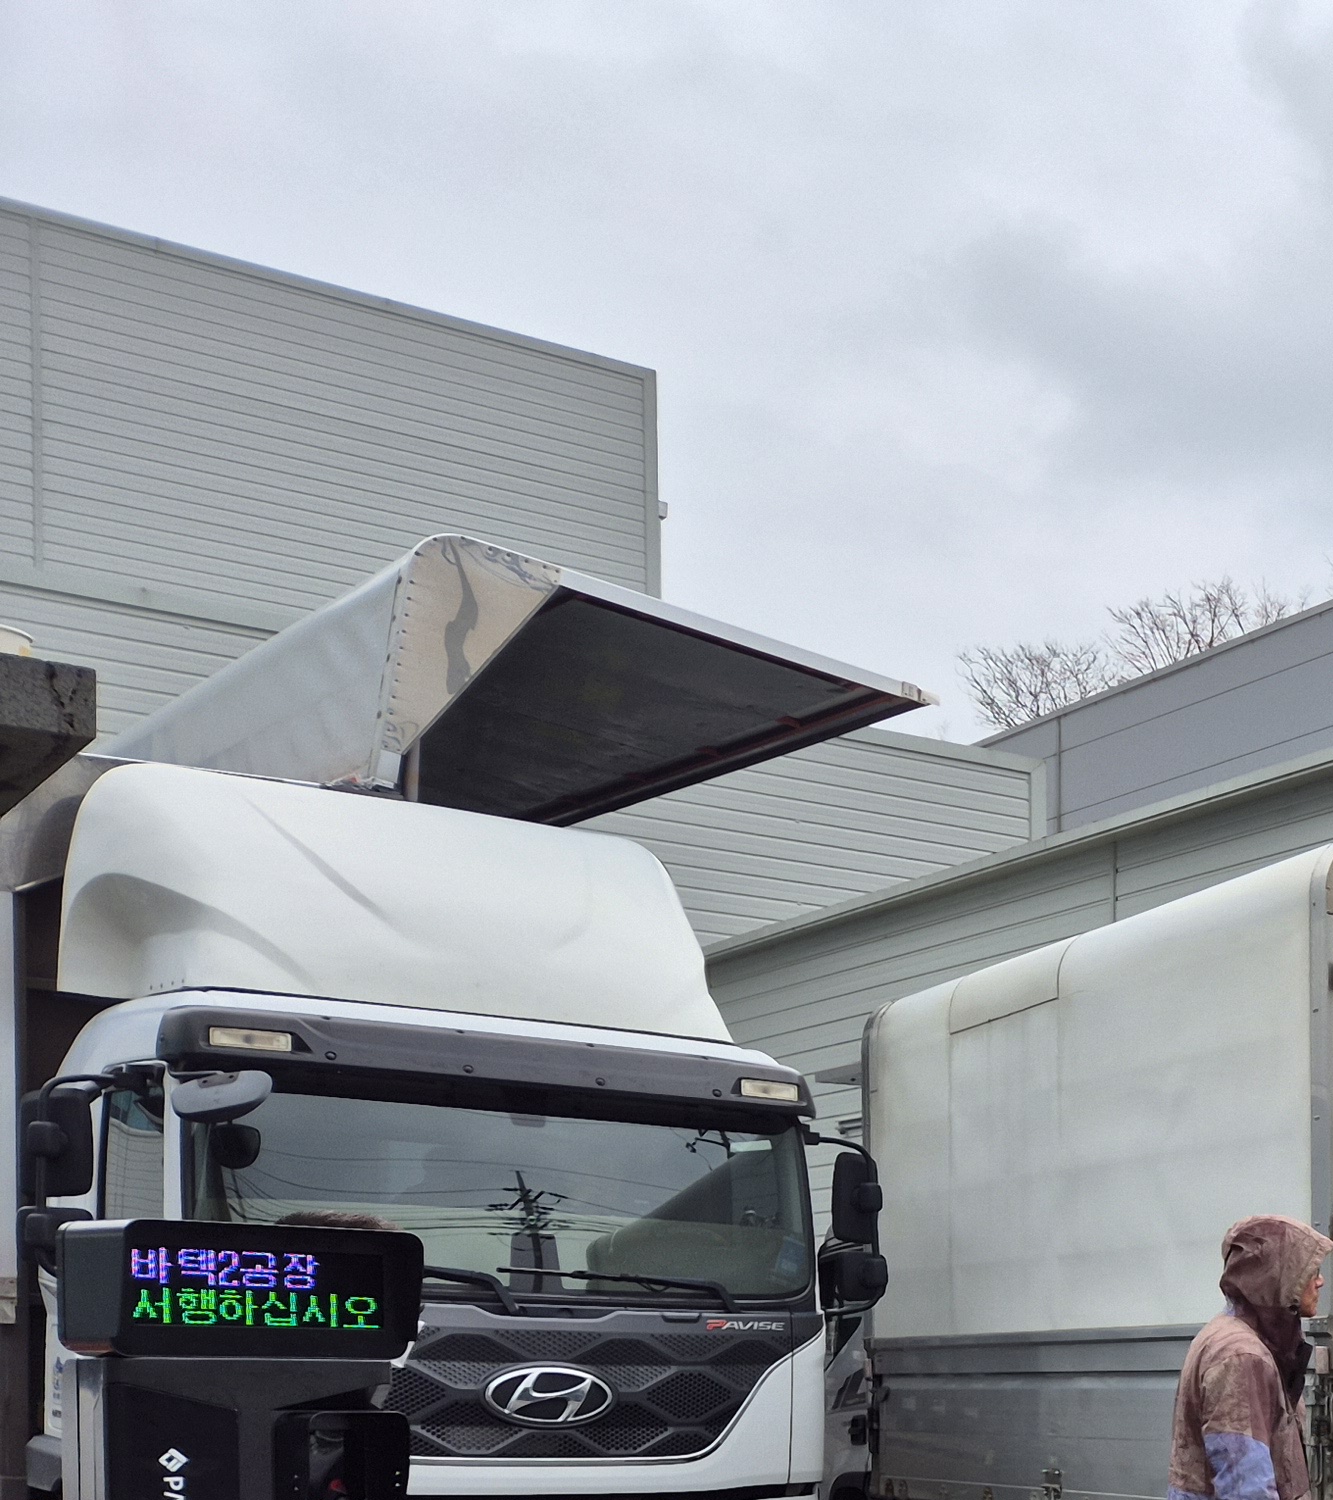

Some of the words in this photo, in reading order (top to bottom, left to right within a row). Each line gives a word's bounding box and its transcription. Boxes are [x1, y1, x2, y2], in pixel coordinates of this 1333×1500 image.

[131, 1247, 321, 1289] 바텍2공장
[131, 1287, 380, 1329] 서행하십시오
[706, 1319, 786, 1332] PAVISE
